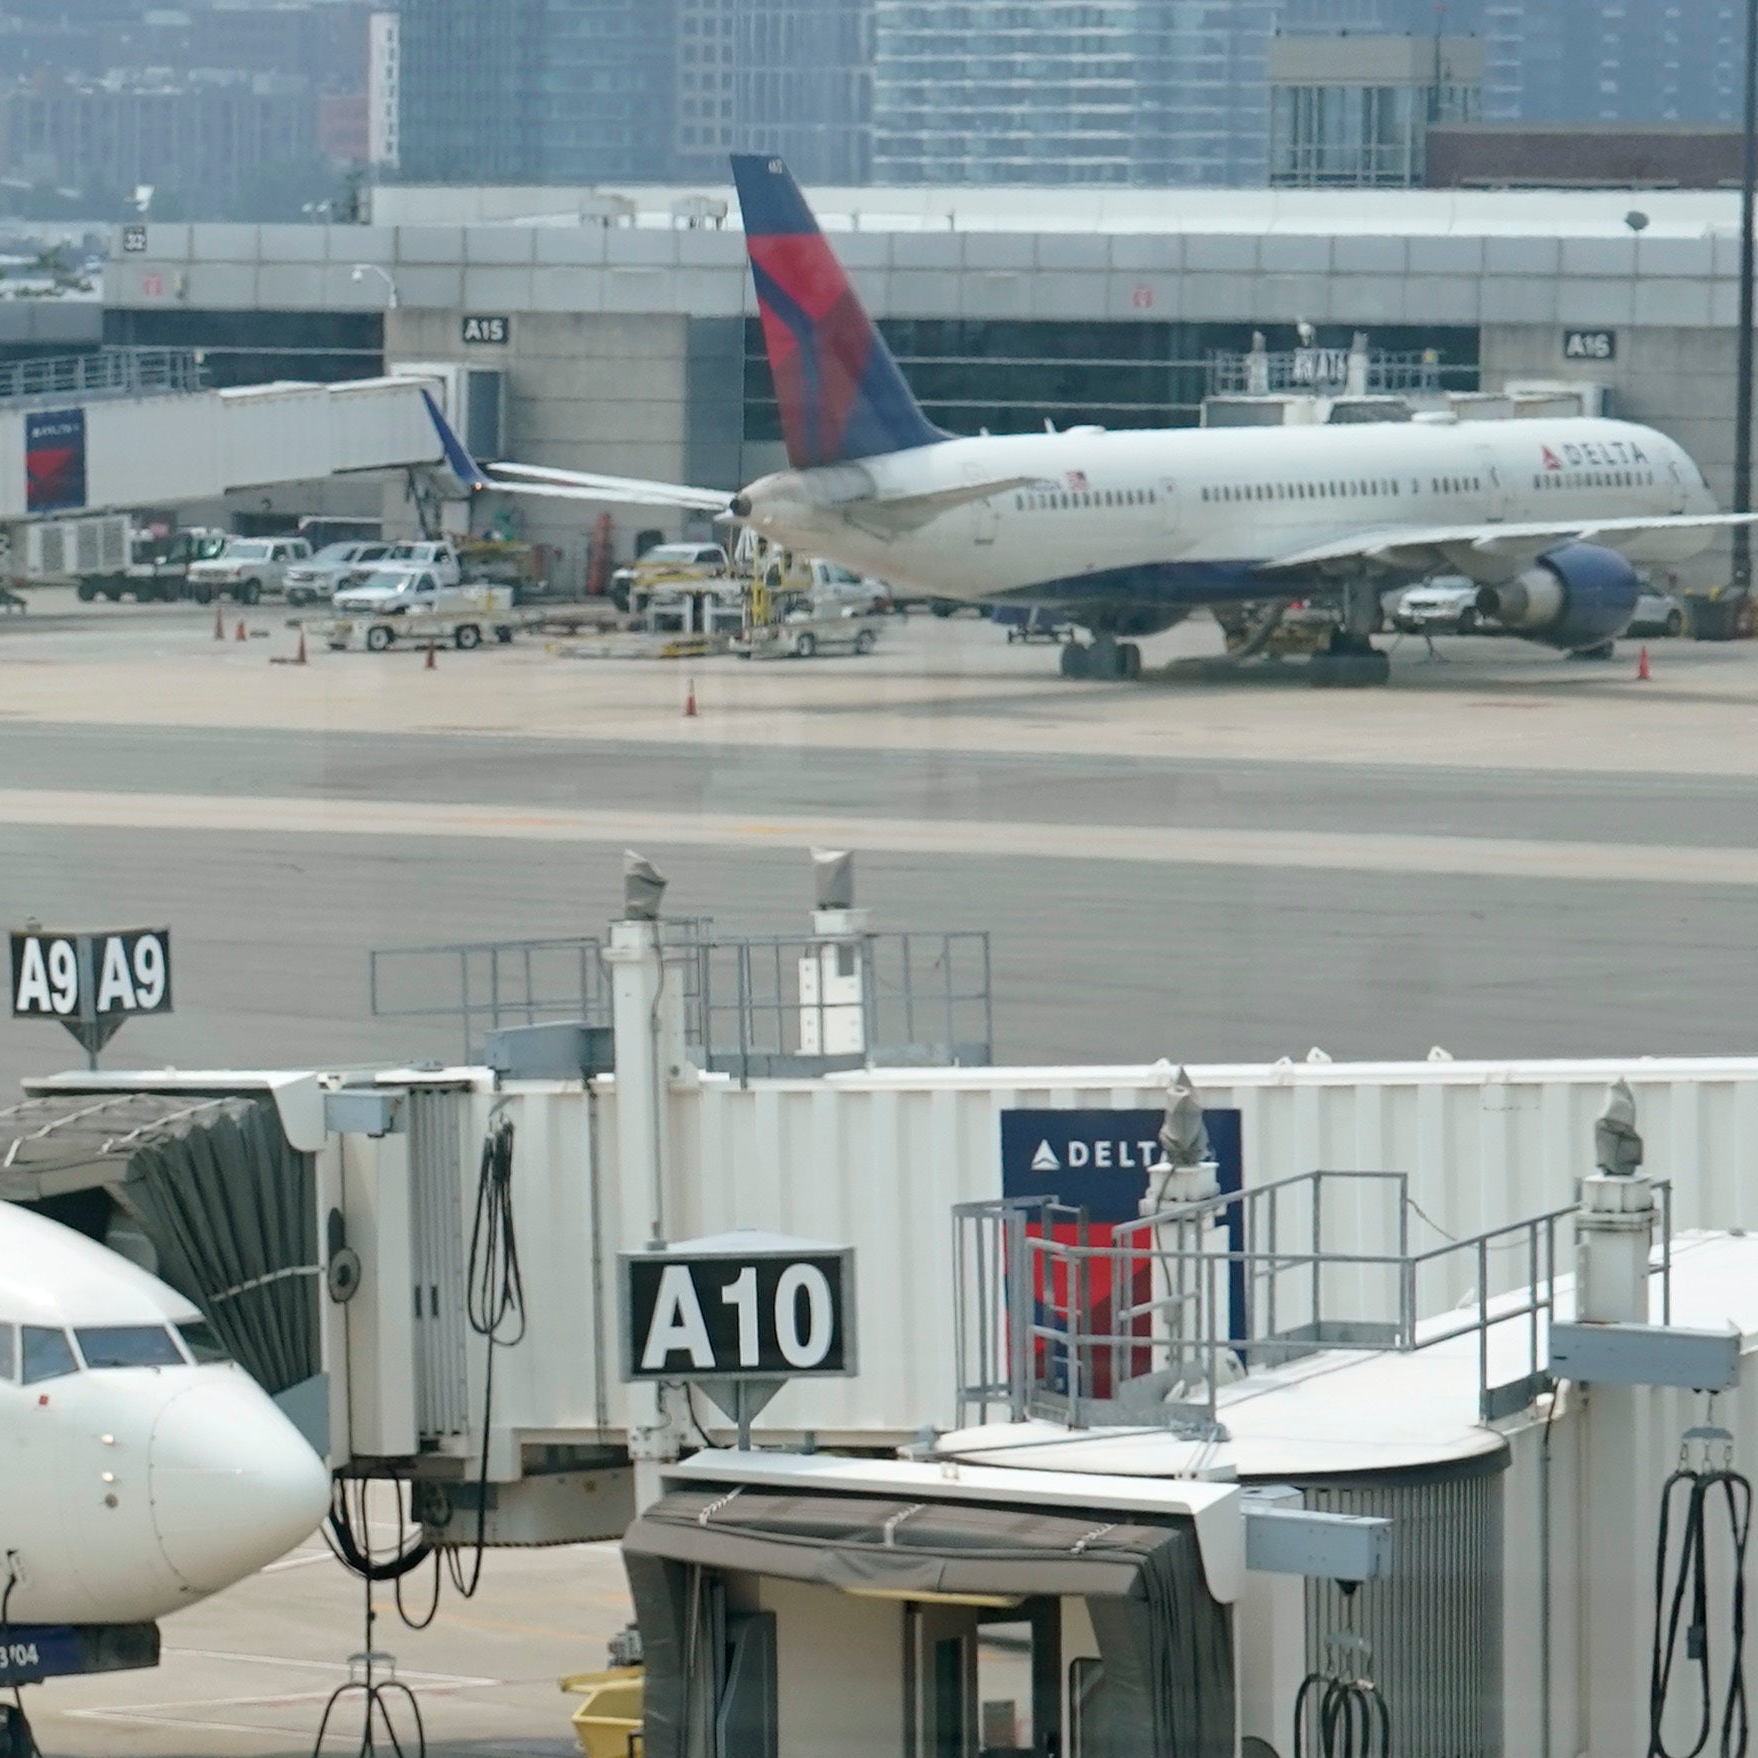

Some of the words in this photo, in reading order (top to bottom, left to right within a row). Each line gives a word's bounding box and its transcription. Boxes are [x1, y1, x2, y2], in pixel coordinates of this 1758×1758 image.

[464, 318, 504, 341] A15
[1563, 441, 1649, 465] DELTA
[16, 937, 79, 1015] A9
[97, 933, 167, 1013] A9
[1067, 1138, 1172, 1170] DELT
[640, 1263, 834, 1371] A10
